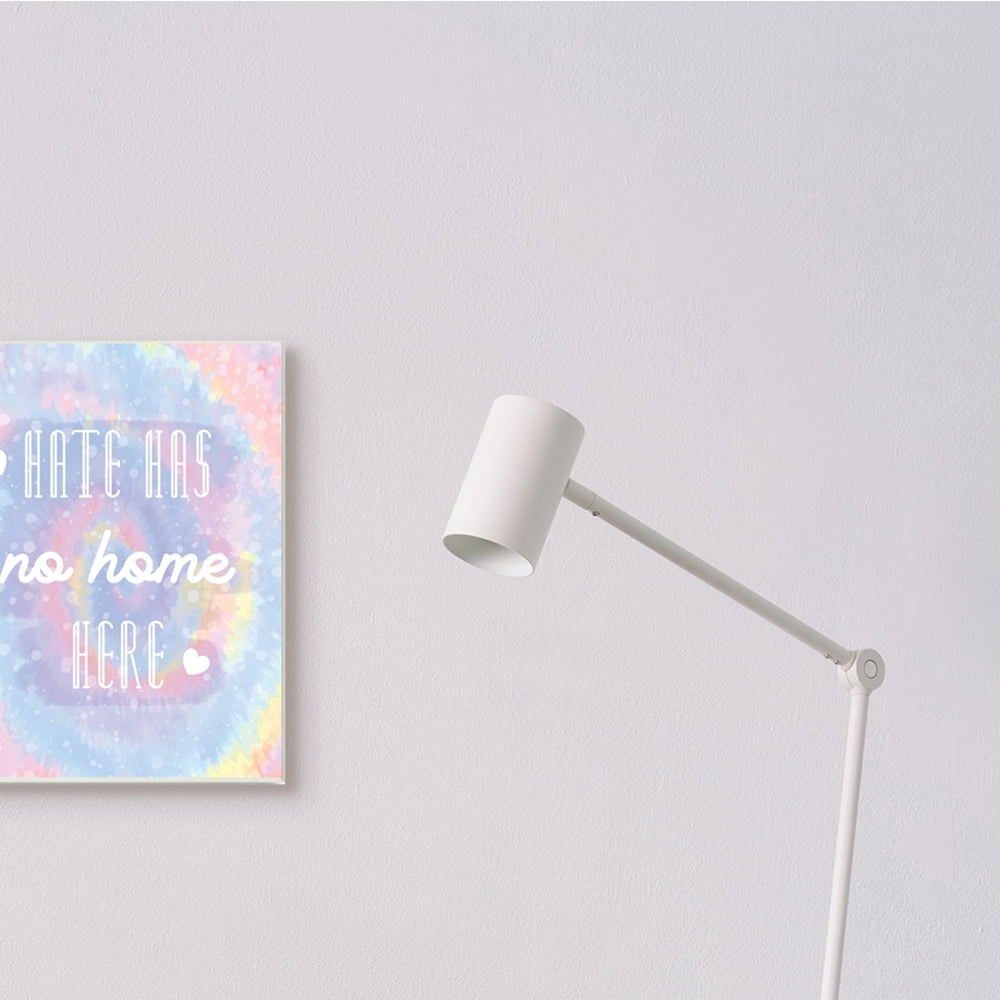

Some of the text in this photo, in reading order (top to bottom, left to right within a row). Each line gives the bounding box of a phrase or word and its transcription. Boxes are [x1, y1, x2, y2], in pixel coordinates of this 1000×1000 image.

[24, 430, 212, 499] HATE HAS
[0, 530, 236, 584] no home
[72, 620, 165, 690] HERE
